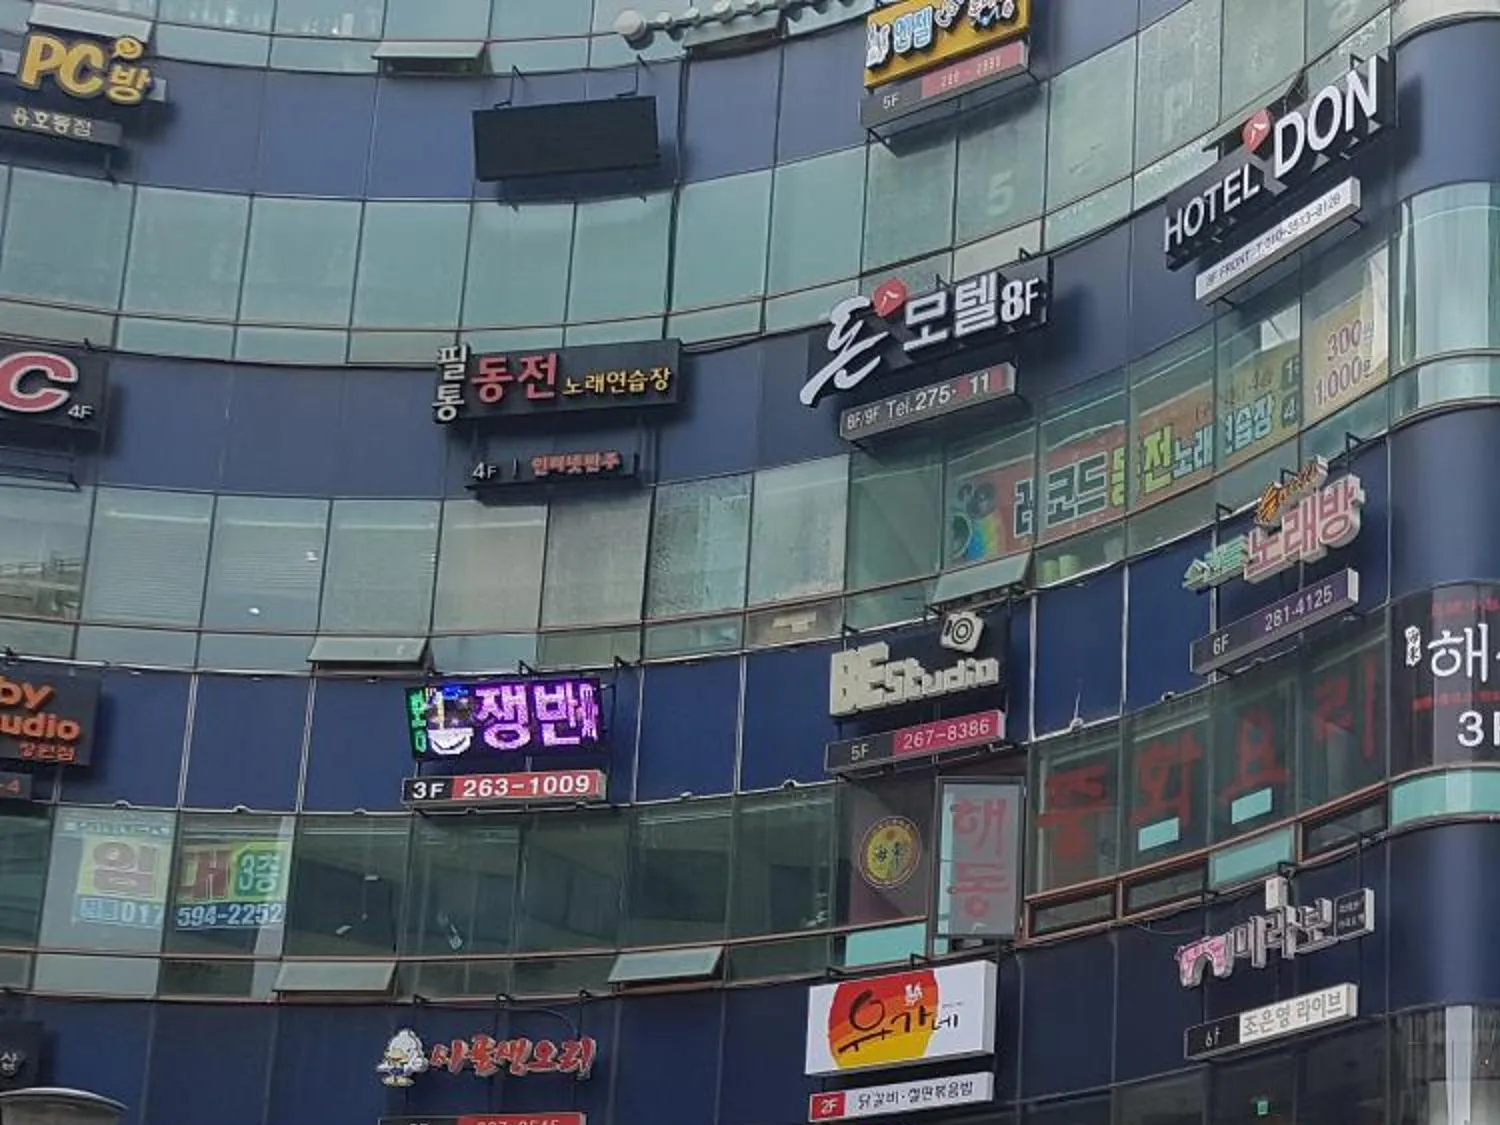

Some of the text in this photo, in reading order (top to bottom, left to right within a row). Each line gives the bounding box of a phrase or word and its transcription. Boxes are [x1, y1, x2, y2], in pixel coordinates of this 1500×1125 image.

[20, 35, 152, 104] PC방
[1163, 166, 1263, 254] HOTEL
[1272, 54, 1379, 180] DON
[903, 271, 1000, 353] 모텔
[1000, 276, 1042, 324] 8F
[433, 345, 469, 423] 필통
[471, 351, 673, 402] 동전 노래연습장
[68, 403, 93, 421] 4F
[472, 461, 498, 480] 4F
[1244, 473, 1366, 581] 노래방
[1212, 634, 1230, 656] 6F
[850, 717, 992, 763] 5F 267-8386
[412, 774, 591, 800] 3F 263-1009
[820, 1098, 838, 1116] 2F
